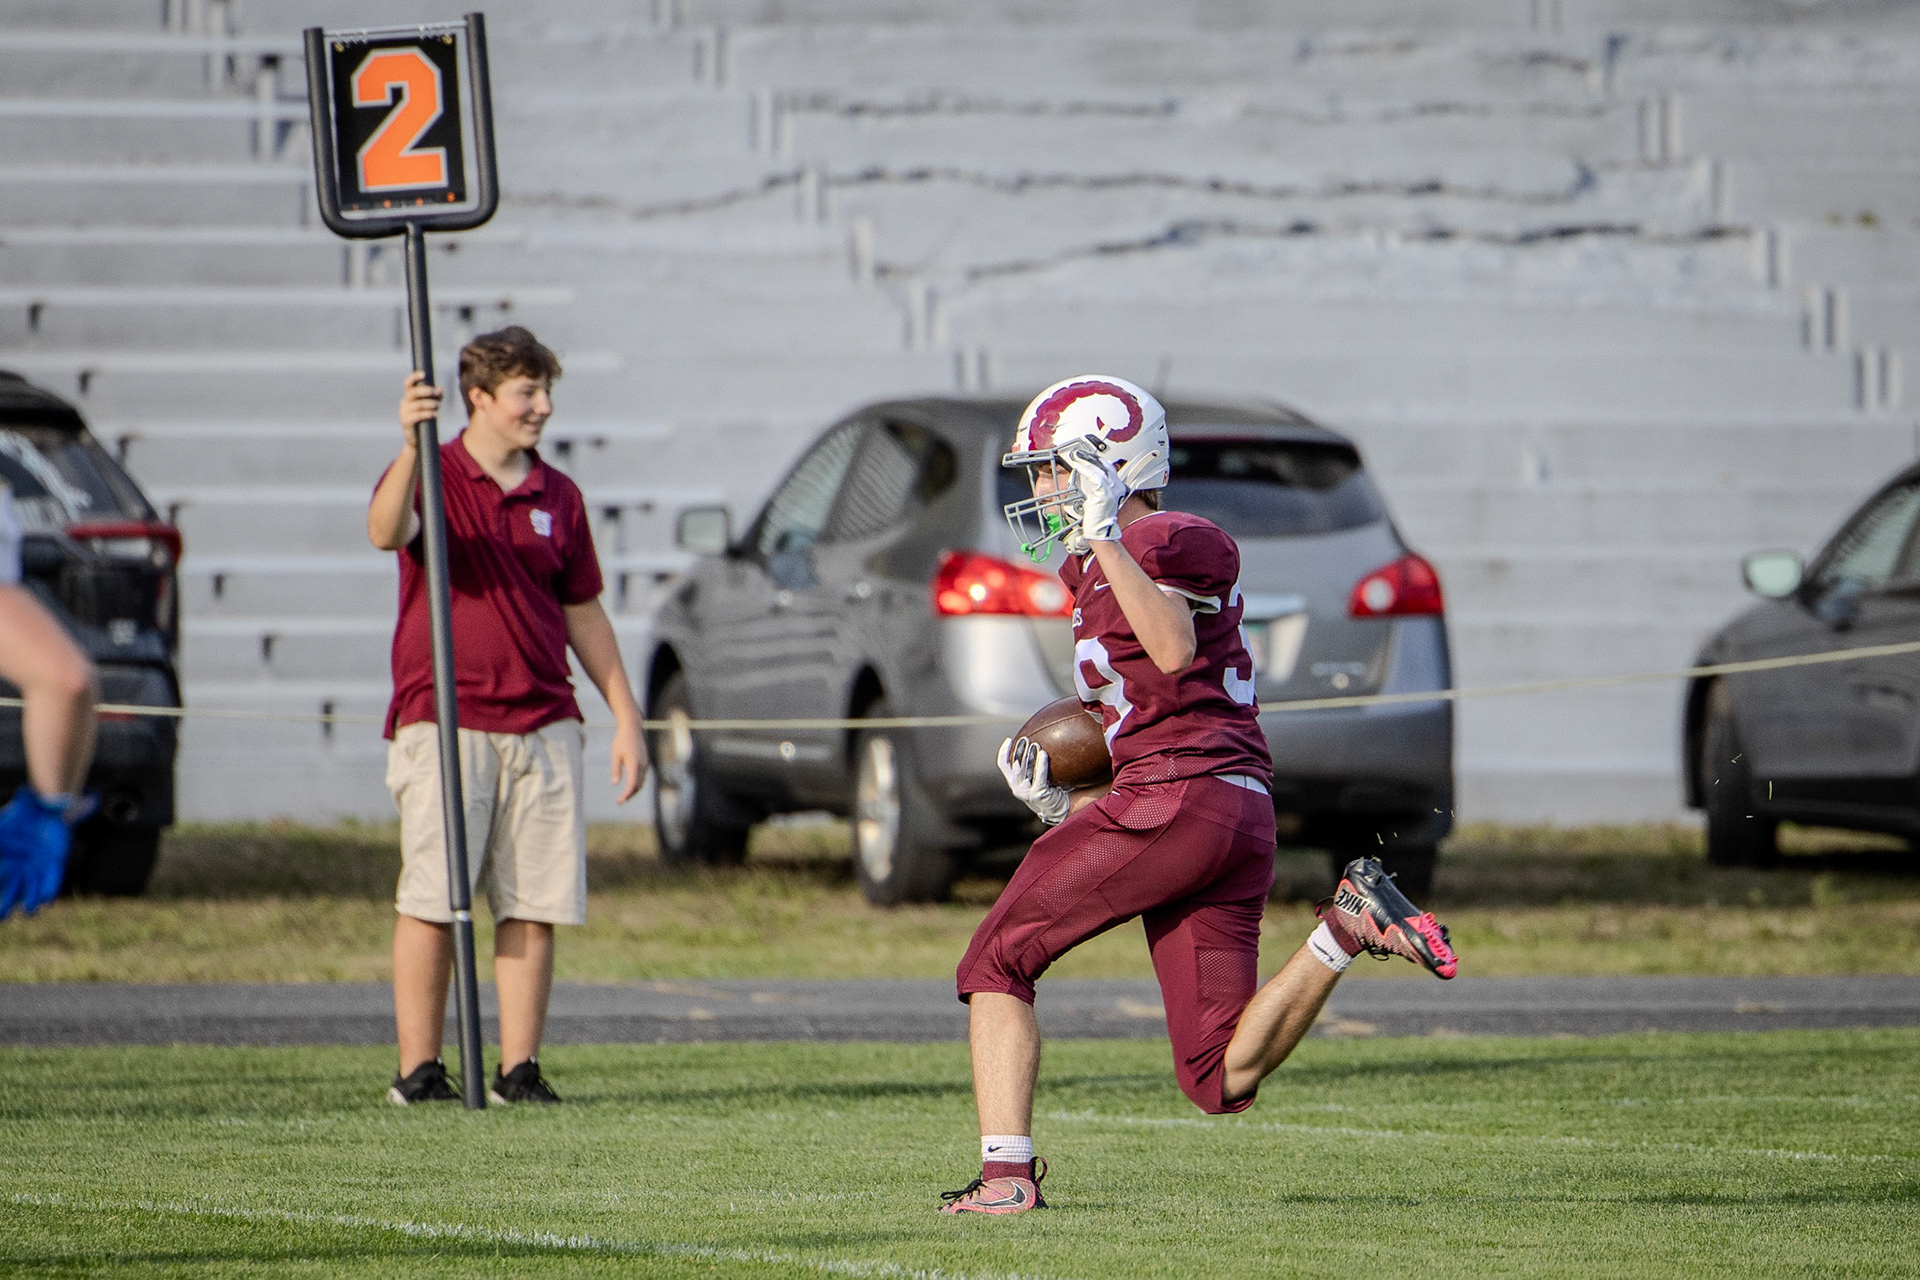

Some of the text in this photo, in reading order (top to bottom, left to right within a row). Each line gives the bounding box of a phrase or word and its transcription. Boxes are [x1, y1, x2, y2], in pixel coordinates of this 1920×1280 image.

[351, 46, 449, 193] 2
[1073, 636, 1134, 757] 9
[1335, 889, 1368, 915] NIKE
